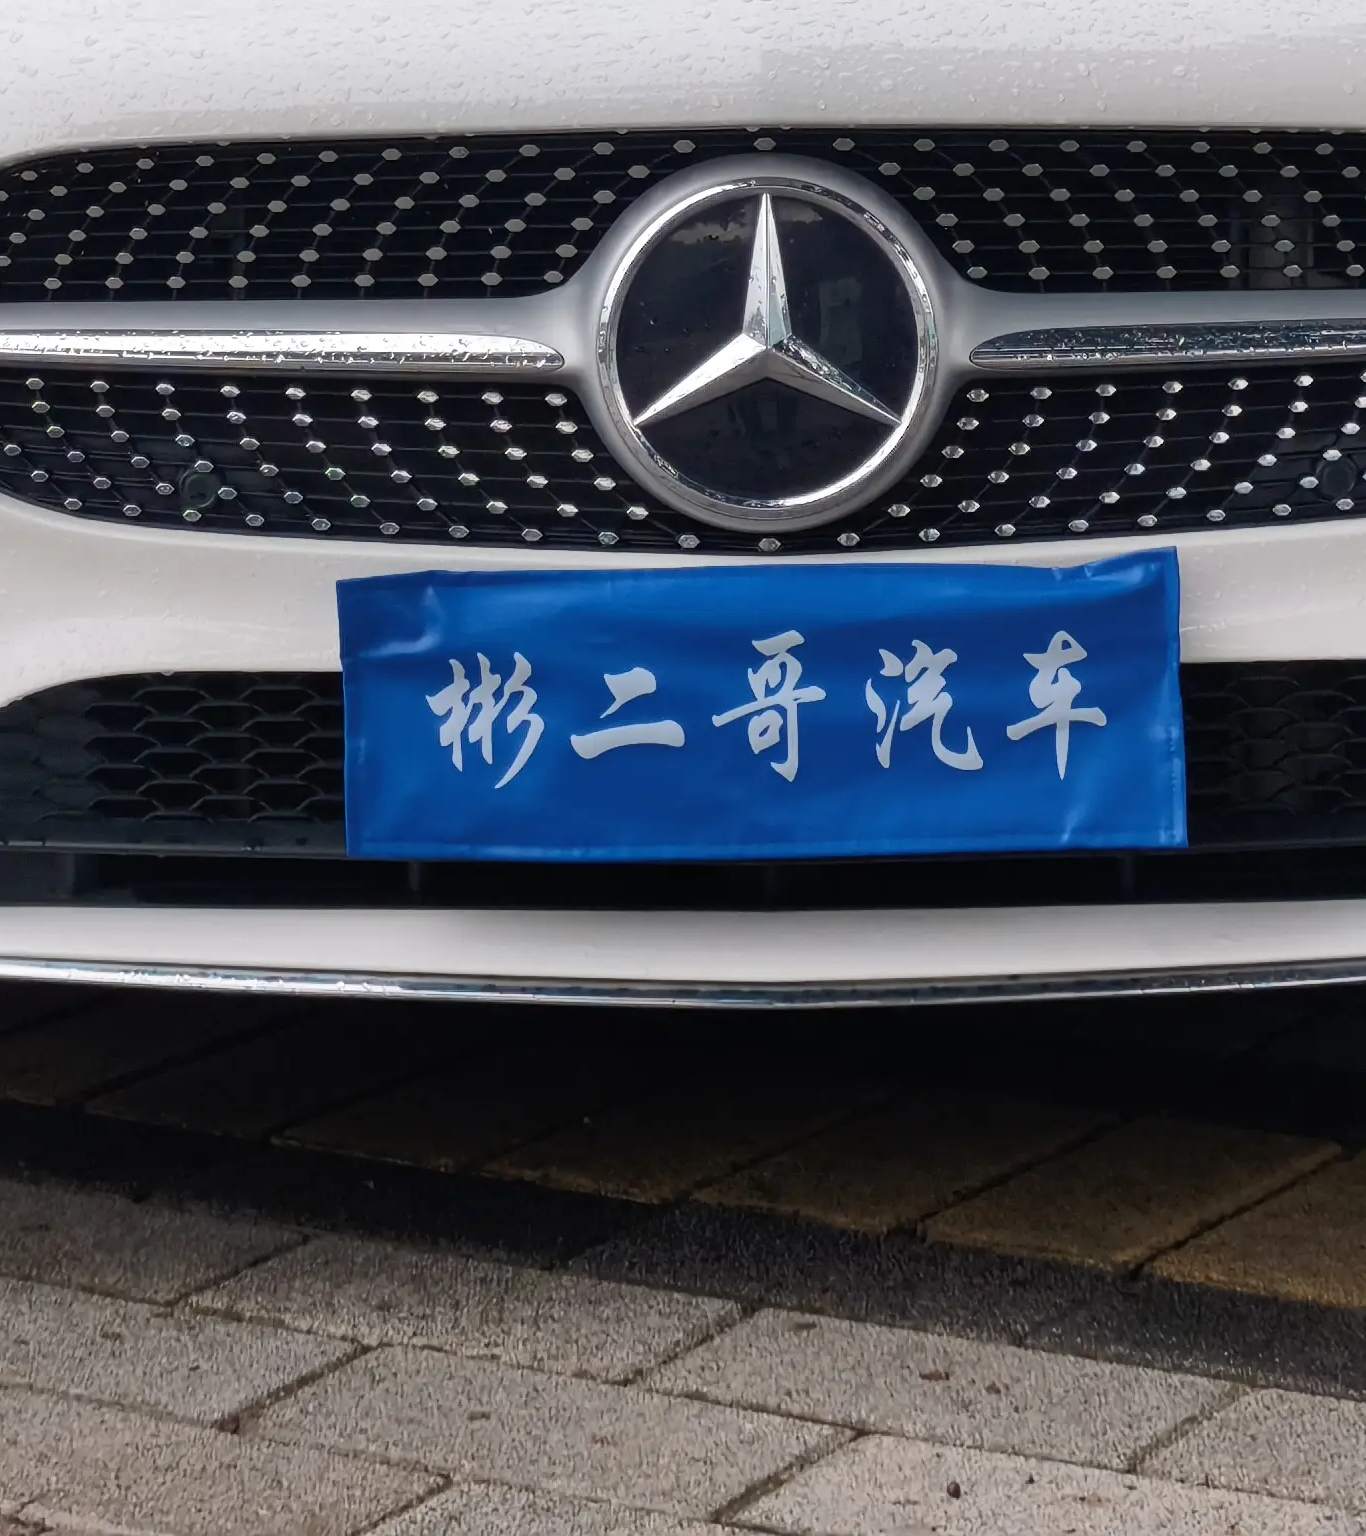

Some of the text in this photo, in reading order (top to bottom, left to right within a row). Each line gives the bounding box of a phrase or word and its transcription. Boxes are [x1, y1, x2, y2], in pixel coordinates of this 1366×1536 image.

[425, 630, 1107, 789] 彬二哥汽车
